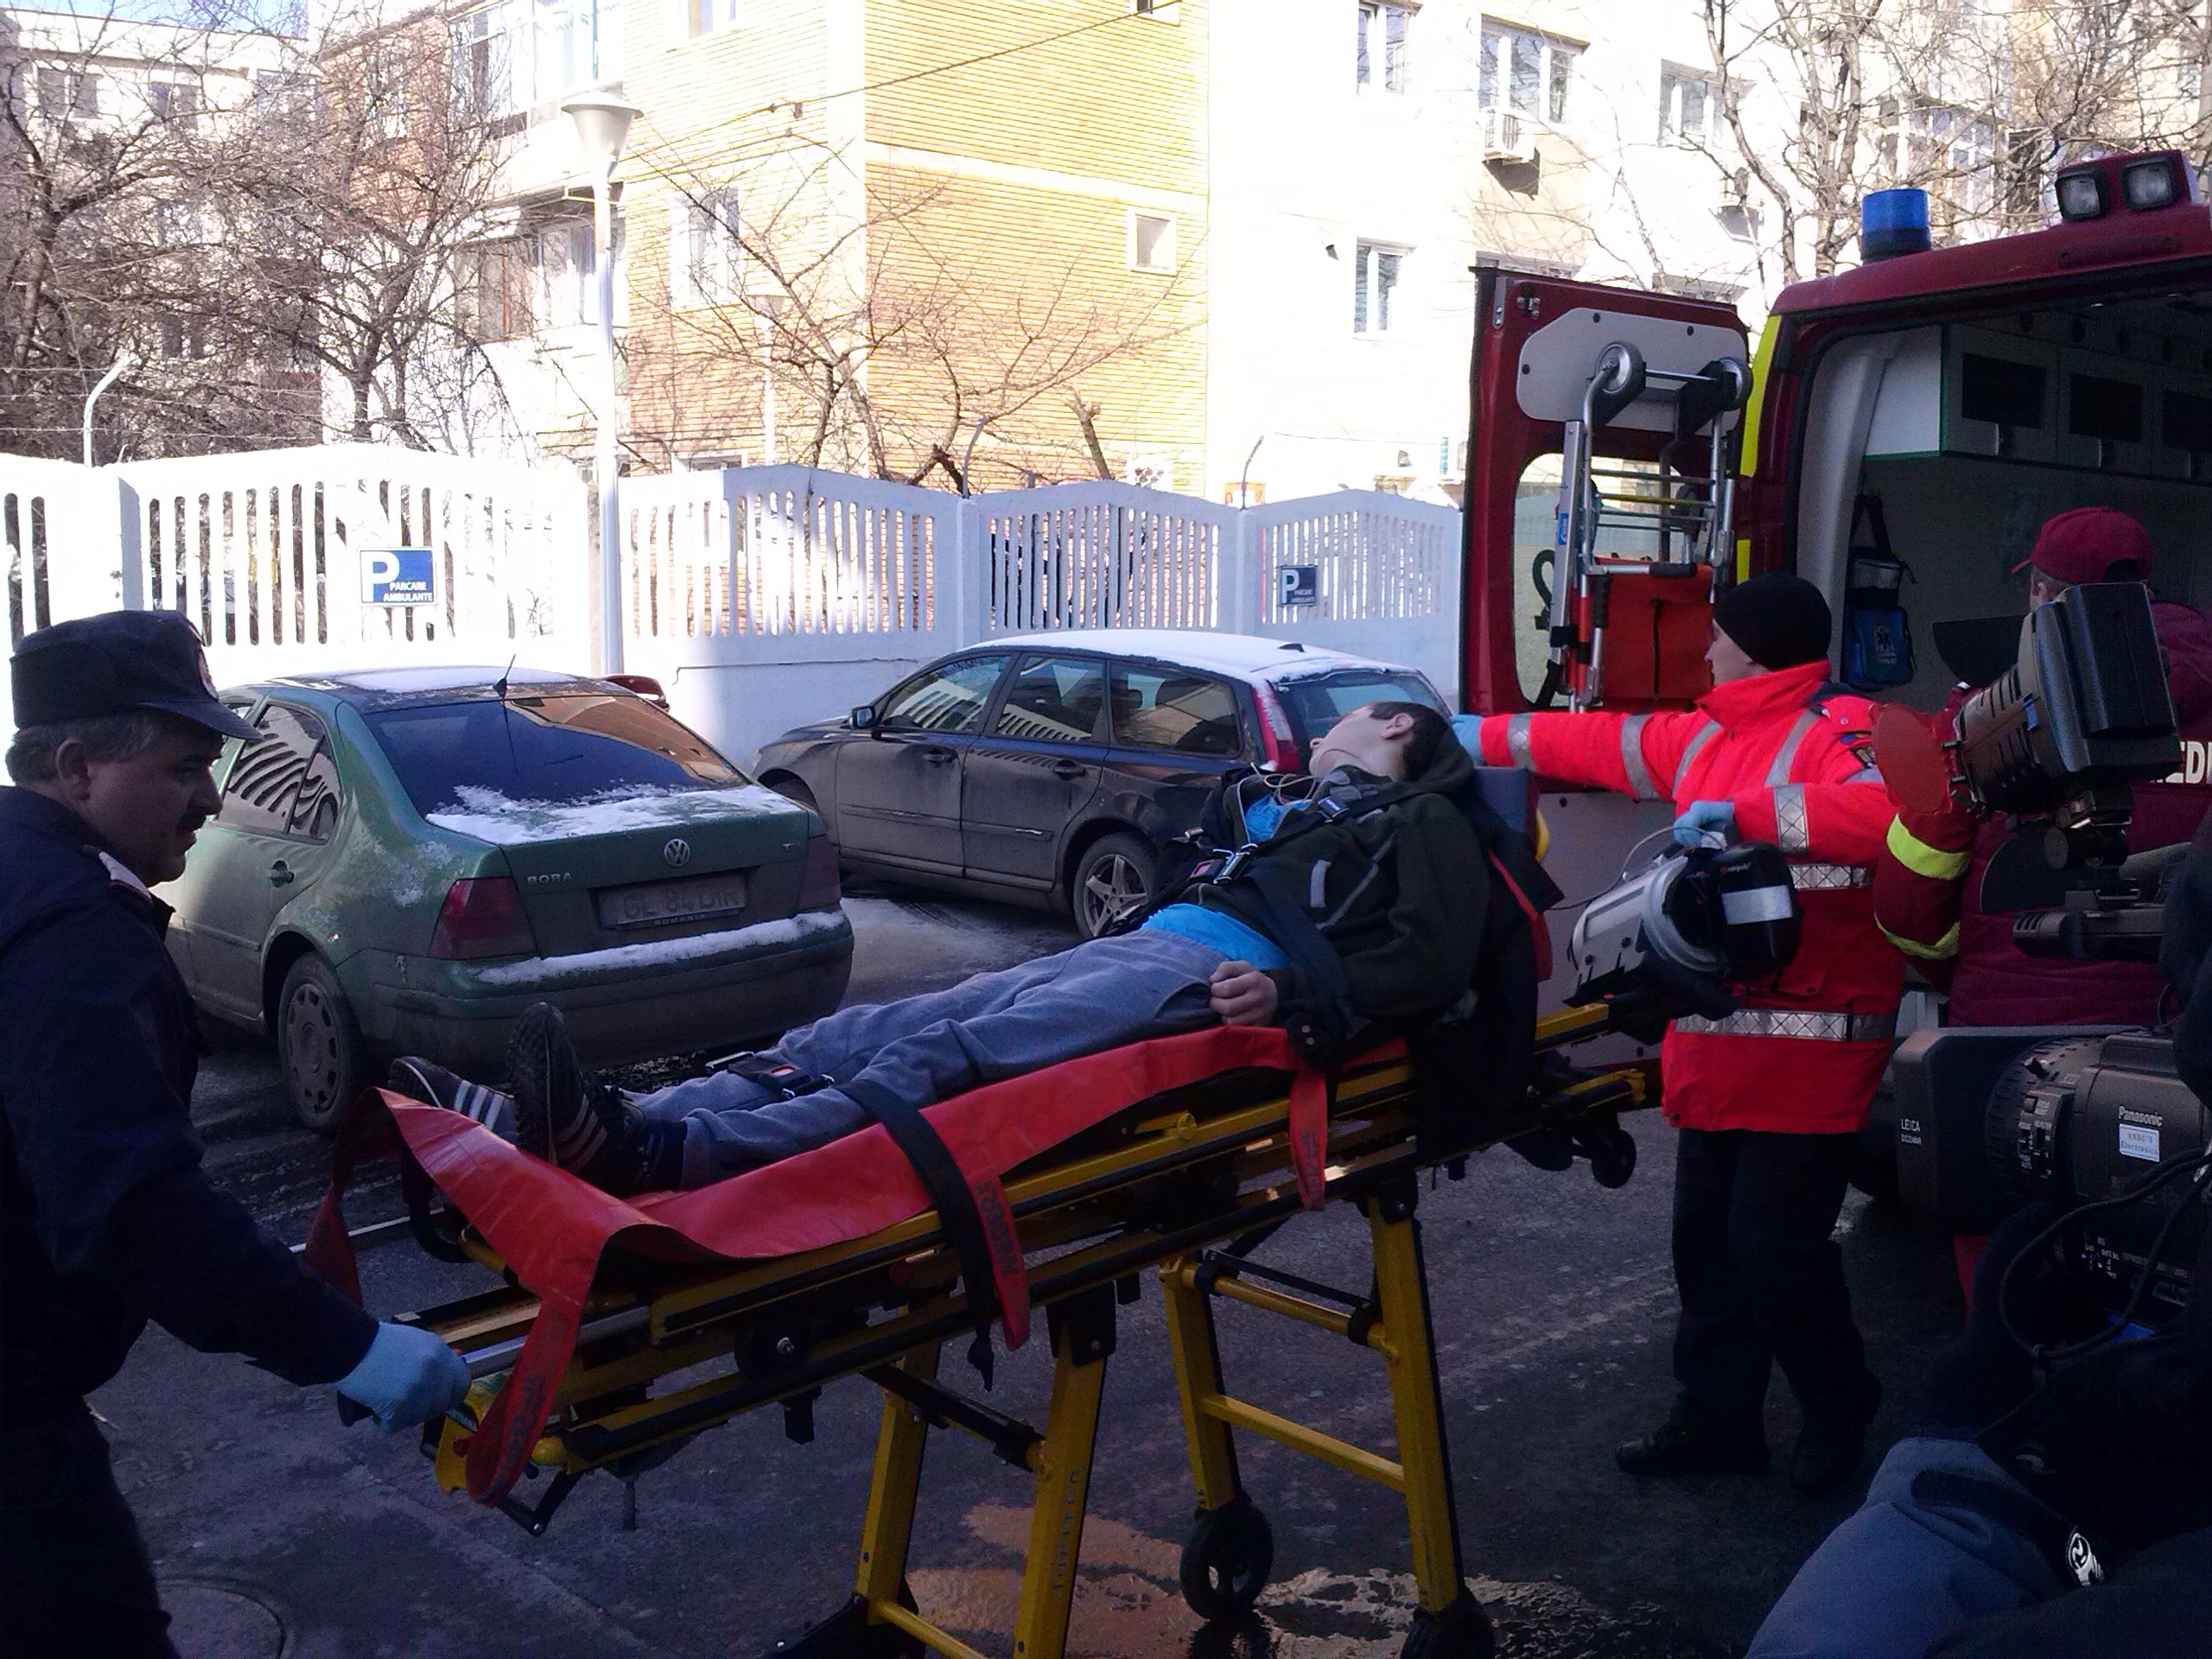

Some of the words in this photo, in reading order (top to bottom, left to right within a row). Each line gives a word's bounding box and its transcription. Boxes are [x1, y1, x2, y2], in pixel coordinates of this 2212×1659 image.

[360, 551, 400, 602] P
[390, 581, 427, 591] PARCARE
[1281, 569, 1300, 604] P
[383, 592, 433, 602] AMBULANTE
[527, 872, 573, 886] BORA
[653, 913, 706, 925] ROMANIA
[2119, 1105, 2163, 1127] Panasonic
[1901, 1118, 1921, 1132] LEICA
